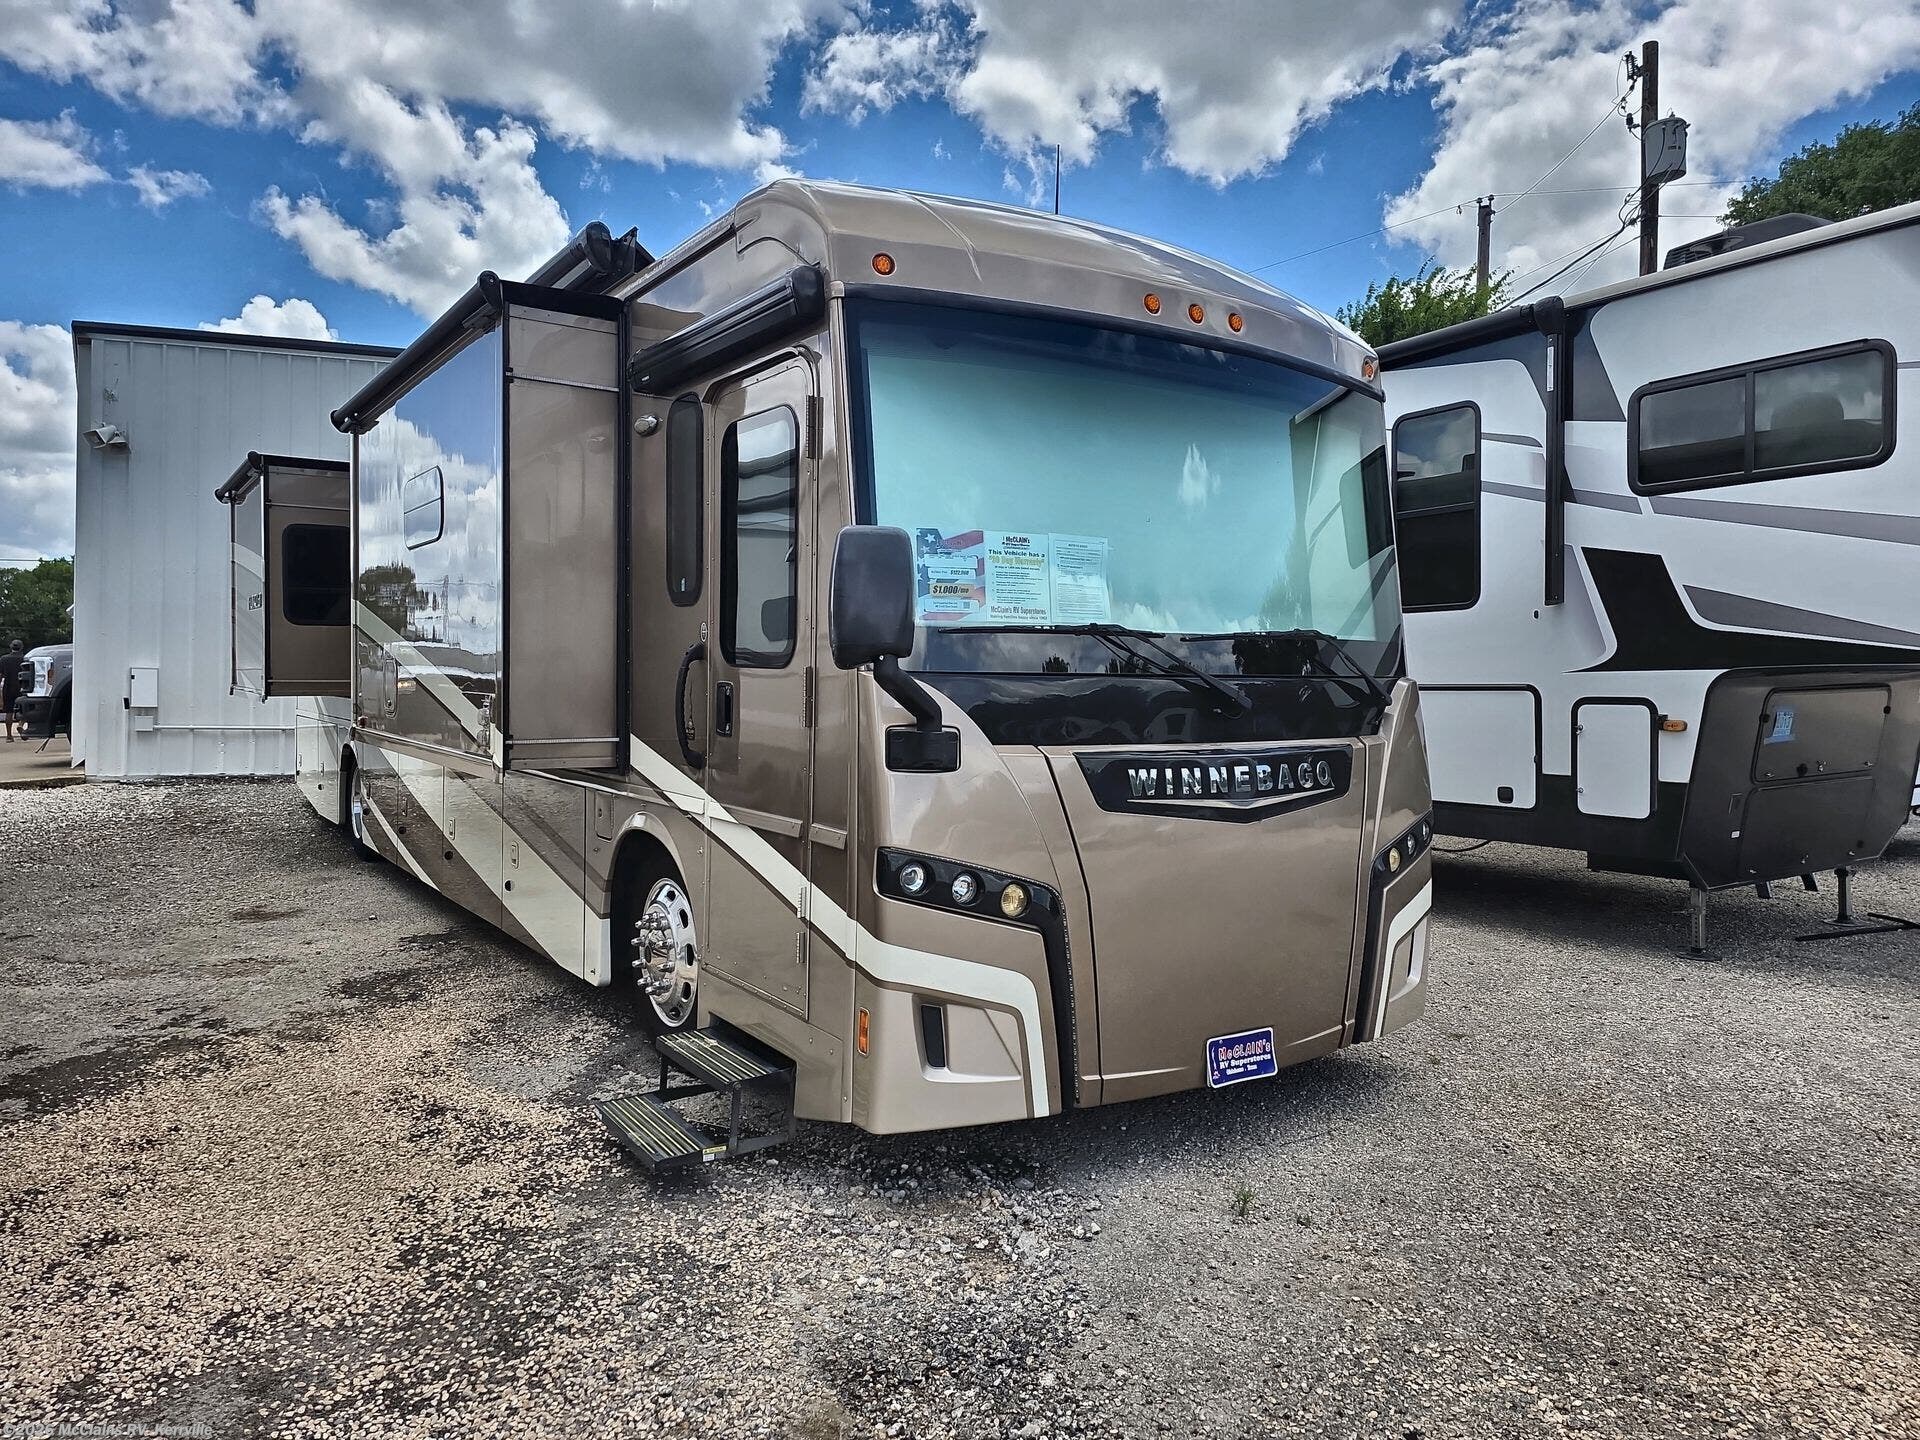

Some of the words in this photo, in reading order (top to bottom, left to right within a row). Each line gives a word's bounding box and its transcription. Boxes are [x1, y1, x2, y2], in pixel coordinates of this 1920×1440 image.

[1128, 760, 1333, 797] WINNEBAGO
[1219, 1060, 1229, 1069] RV
[1231, 1054, 1271, 1067] Superstores
